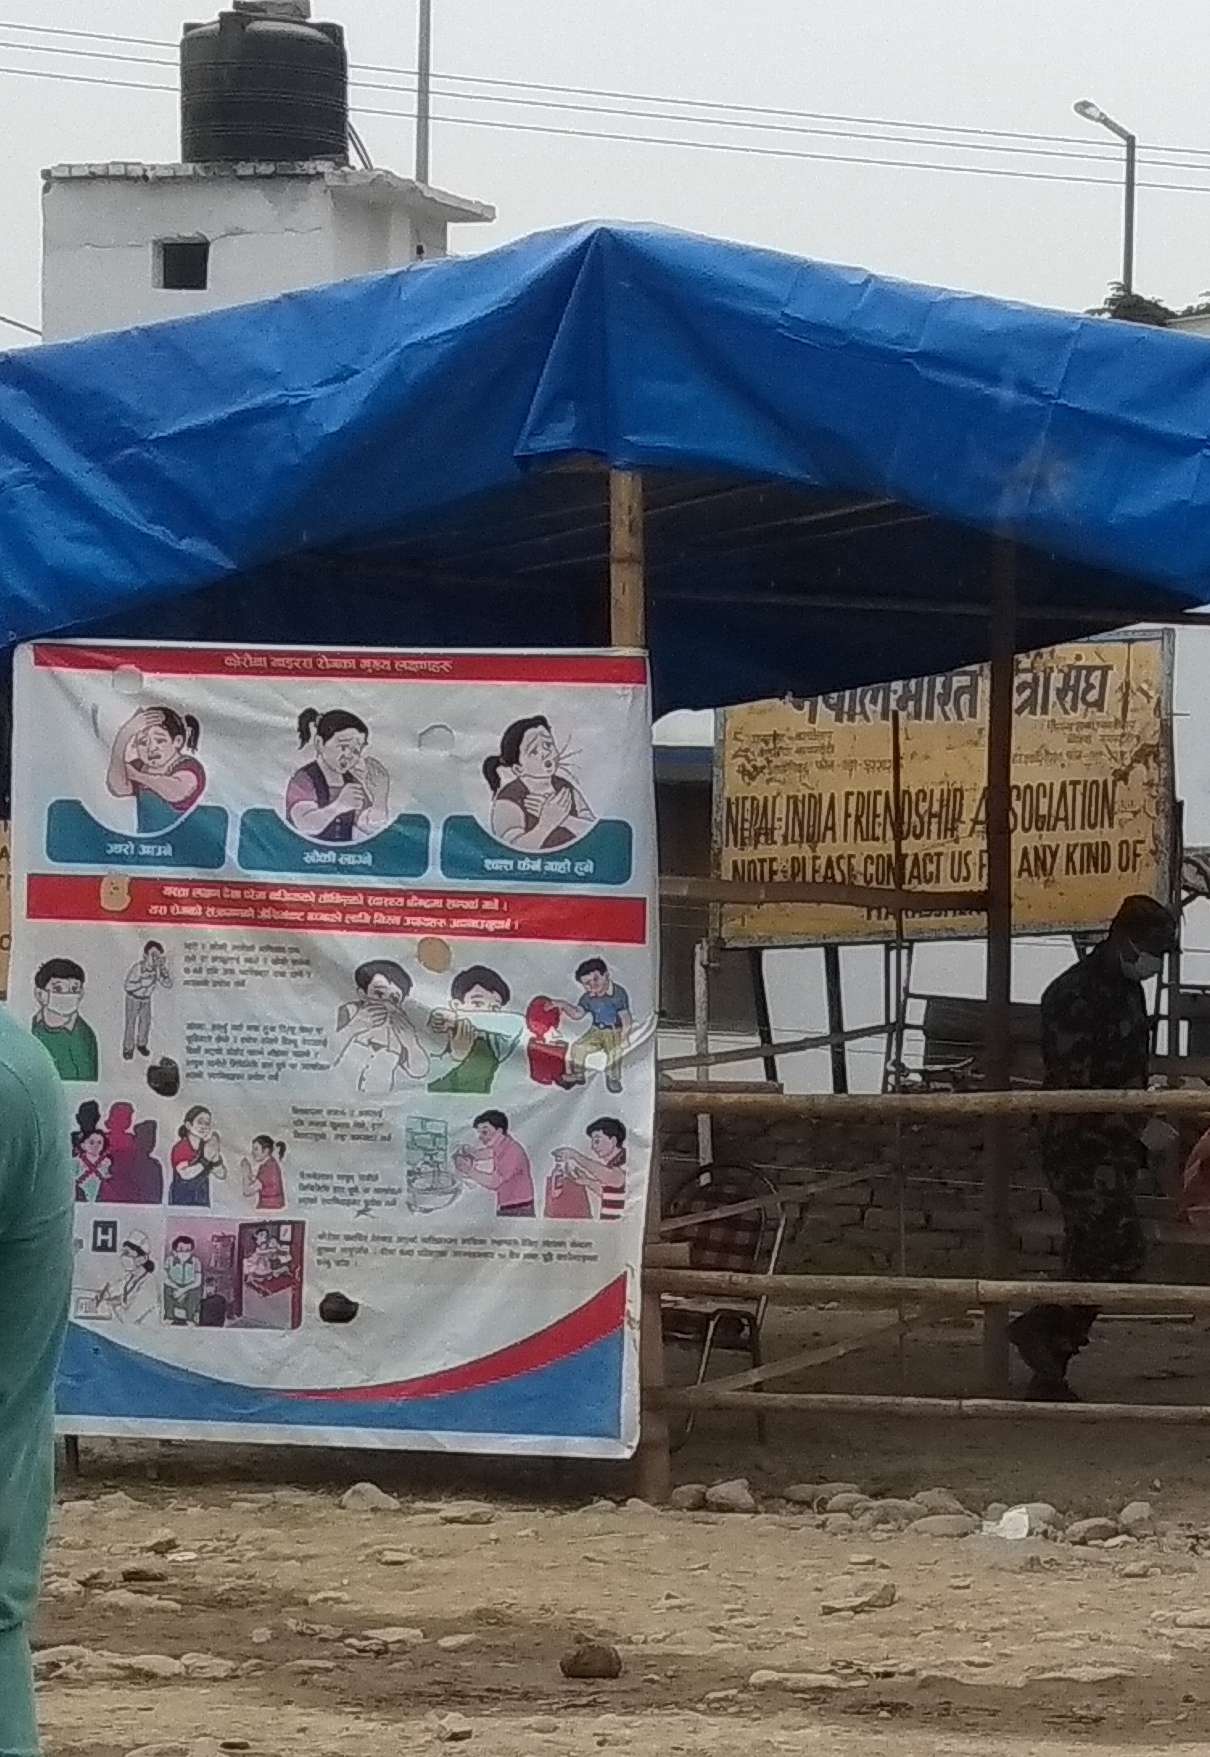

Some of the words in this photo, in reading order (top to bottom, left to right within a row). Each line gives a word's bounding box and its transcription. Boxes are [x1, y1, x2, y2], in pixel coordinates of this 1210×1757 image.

[950, 850, 973, 884] US
[1016, 842, 1061, 880] ANY
[1065, 840, 1112, 876] KIND
[1117, 838, 1146, 874] OF
